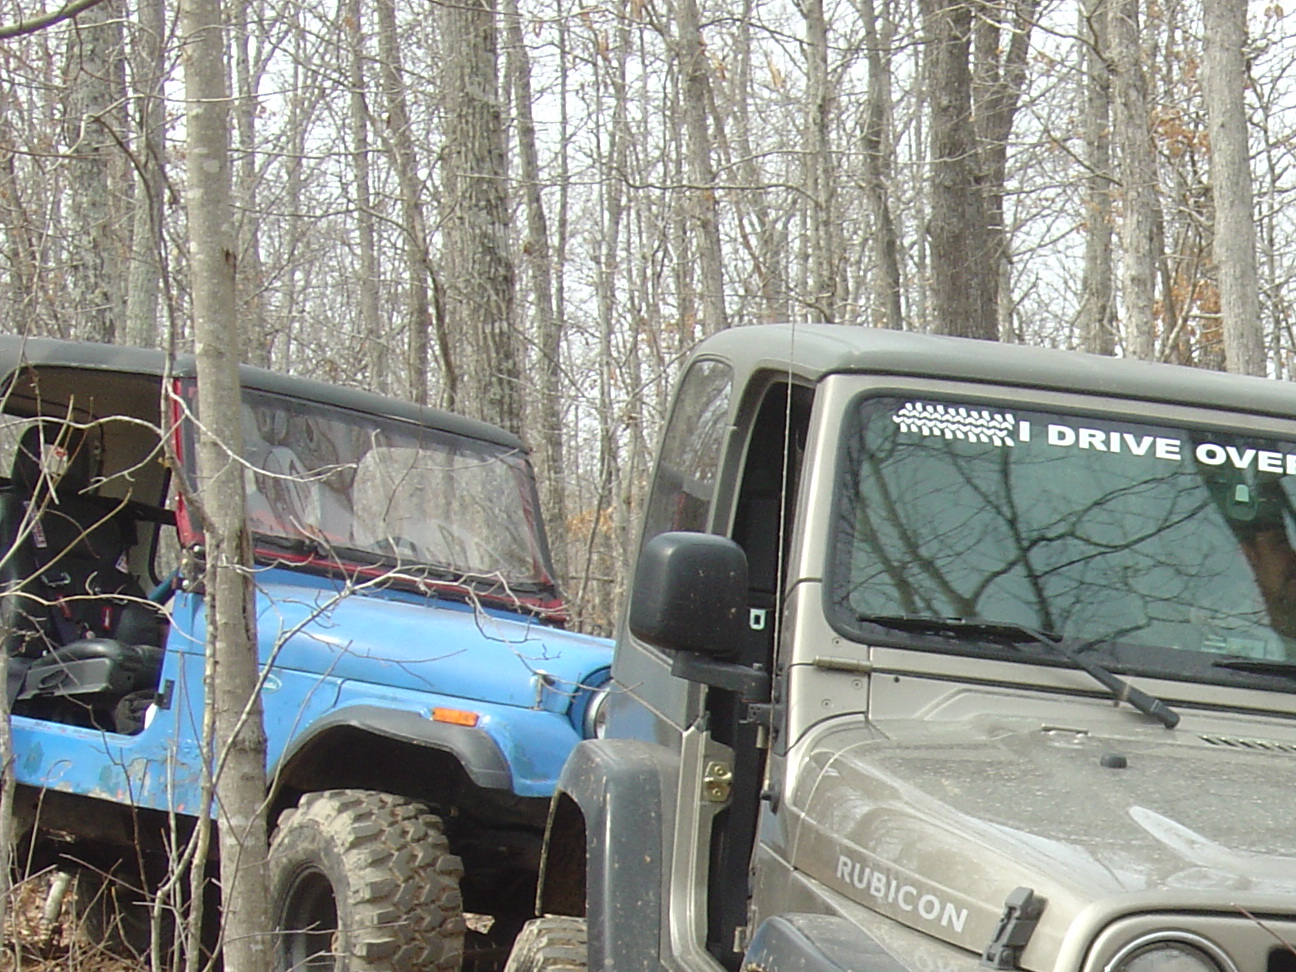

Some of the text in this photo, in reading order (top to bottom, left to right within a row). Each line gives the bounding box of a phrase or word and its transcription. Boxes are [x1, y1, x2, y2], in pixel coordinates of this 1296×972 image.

[1019, 421, 1031, 442] I
[1047, 424, 1182, 461] DRIVE
[836, 854, 969, 934] RUBICON
